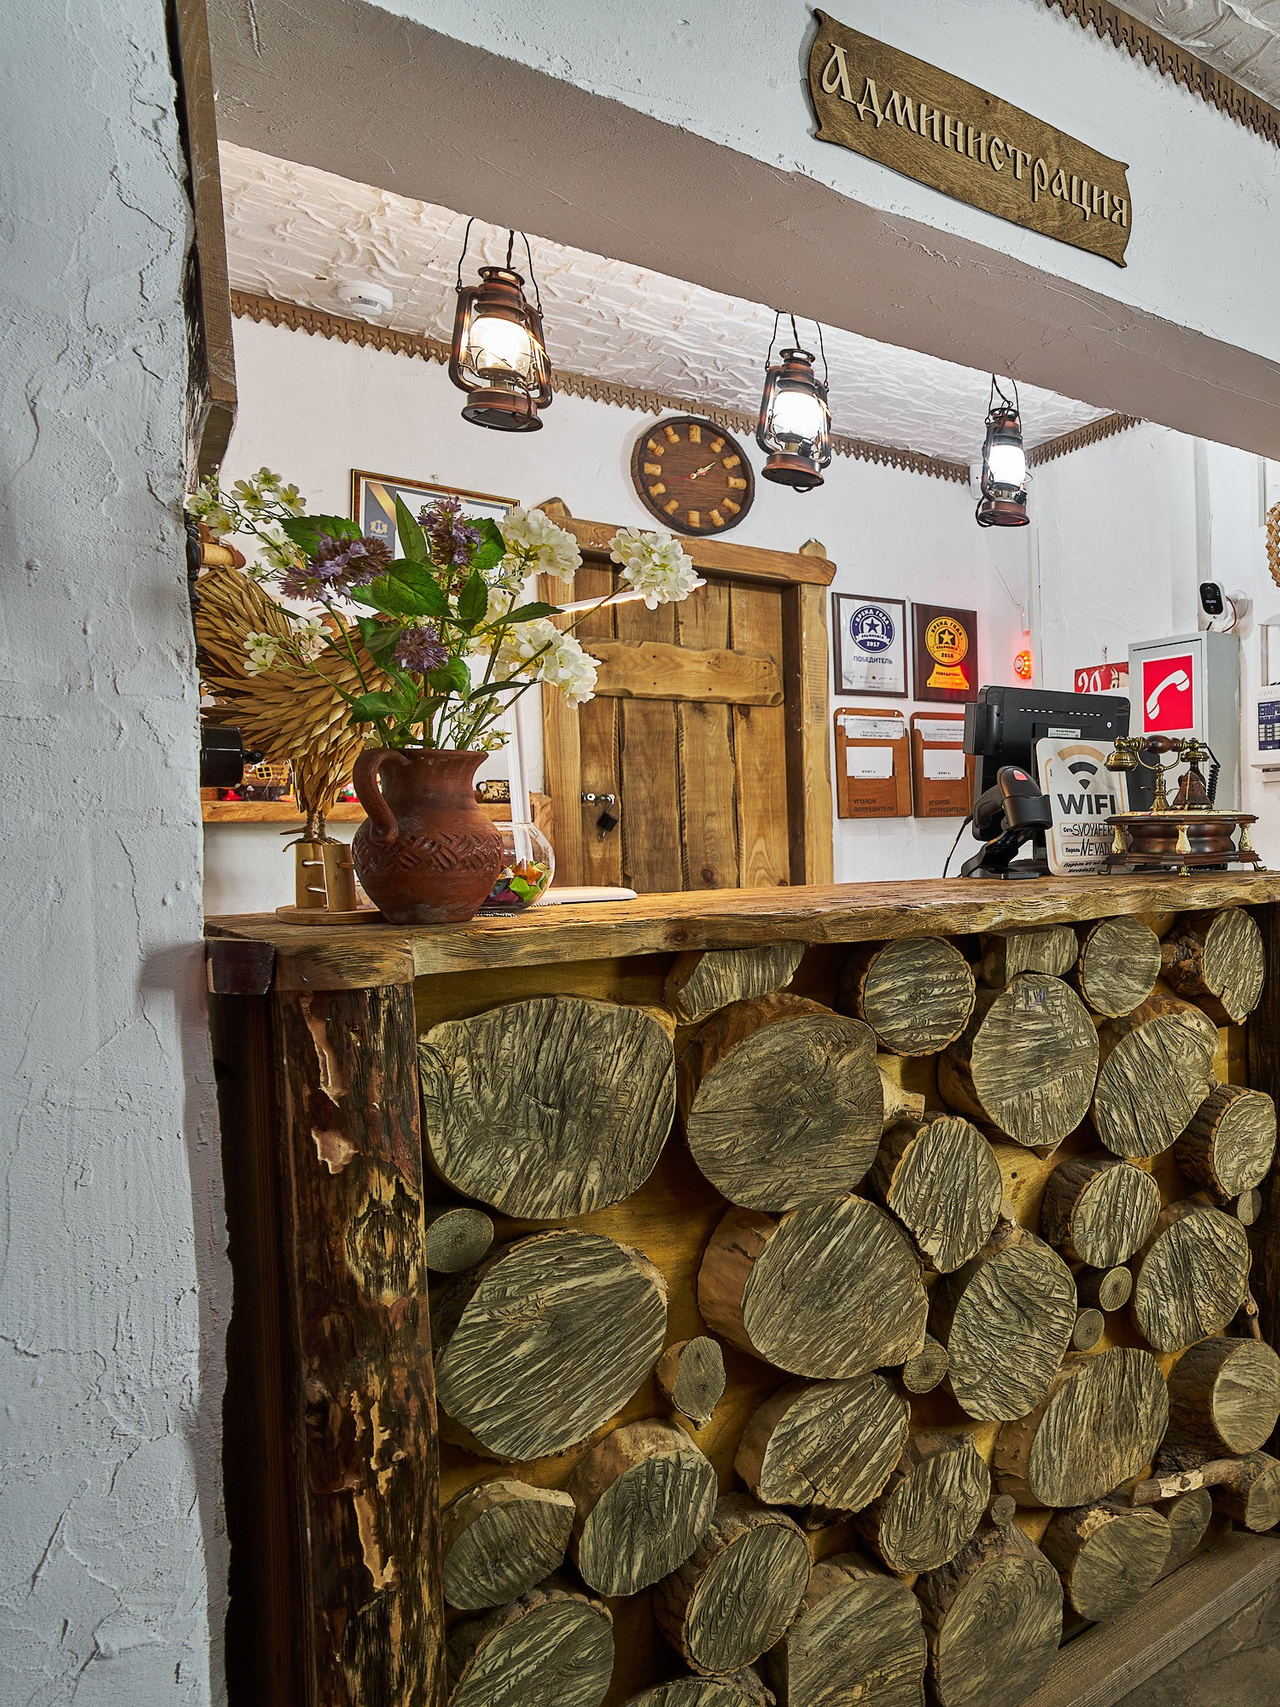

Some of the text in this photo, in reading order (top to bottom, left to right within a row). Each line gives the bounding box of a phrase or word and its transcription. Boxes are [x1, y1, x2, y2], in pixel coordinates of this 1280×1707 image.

[821, 43, 1127, 227] Администрация
[855, 609, 889, 625] БРЕНД ГОДА
[931, 621, 963, 636] БРЕНД ГОДА
[853, 655, 893, 665] ПОБЕДИТЕЛЬ
[1057, 794, 1116, 814] WIFI
[1080, 838, 1112, 856] NEVAD
